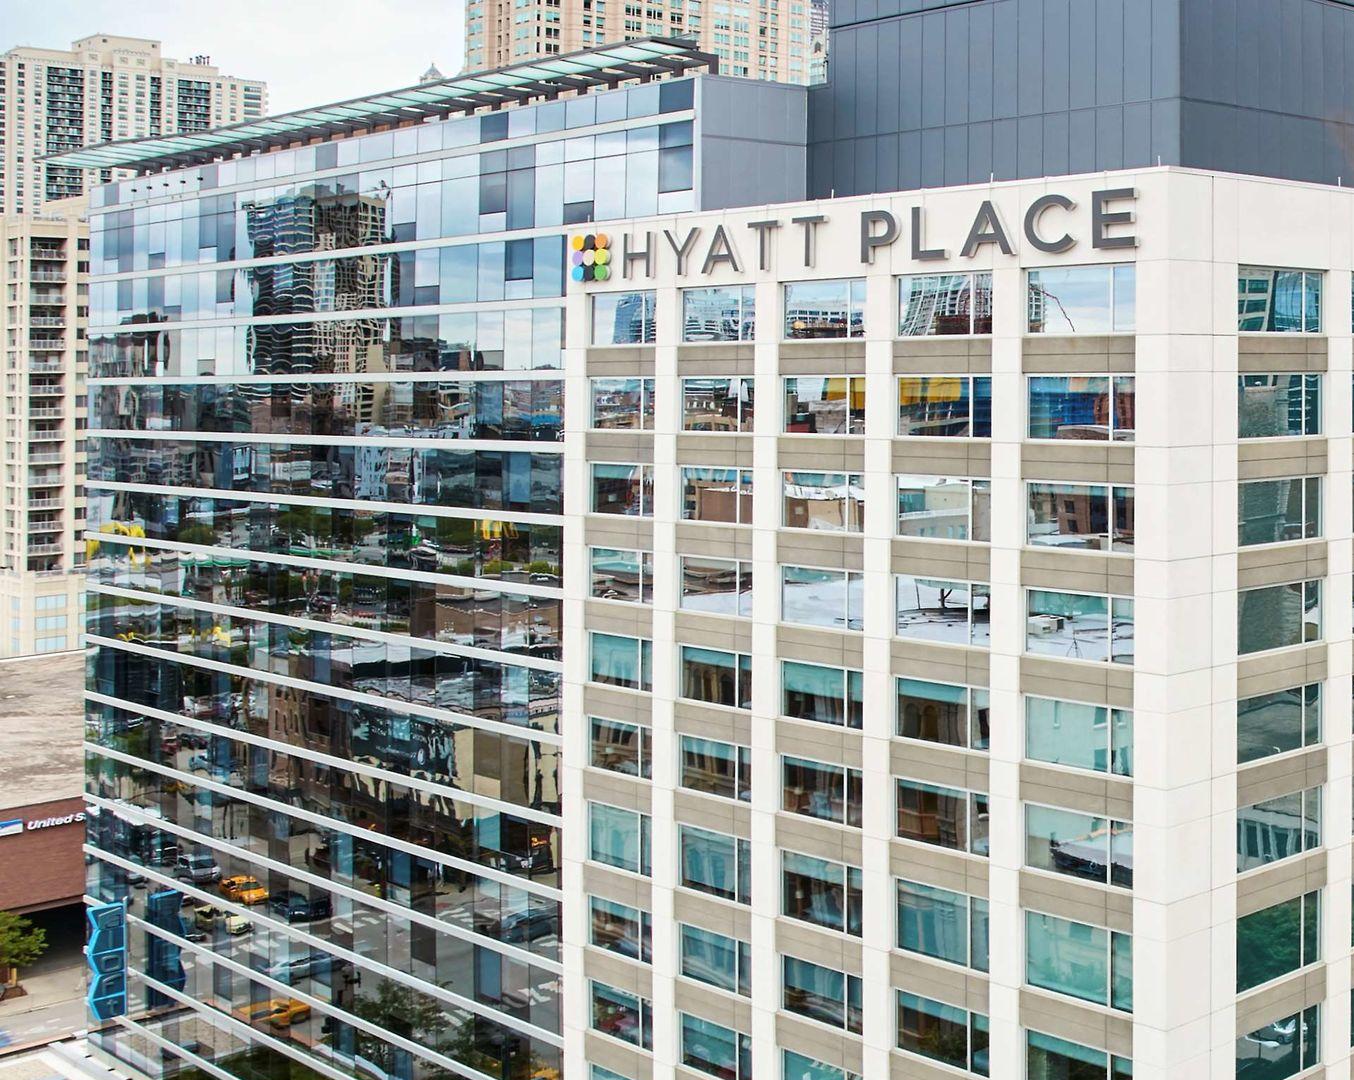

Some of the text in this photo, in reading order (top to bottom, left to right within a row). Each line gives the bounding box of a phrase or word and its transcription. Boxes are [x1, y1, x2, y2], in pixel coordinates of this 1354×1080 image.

[622, 187, 1138, 279] HYATT PLACE
[27, 814, 74, 830] United
